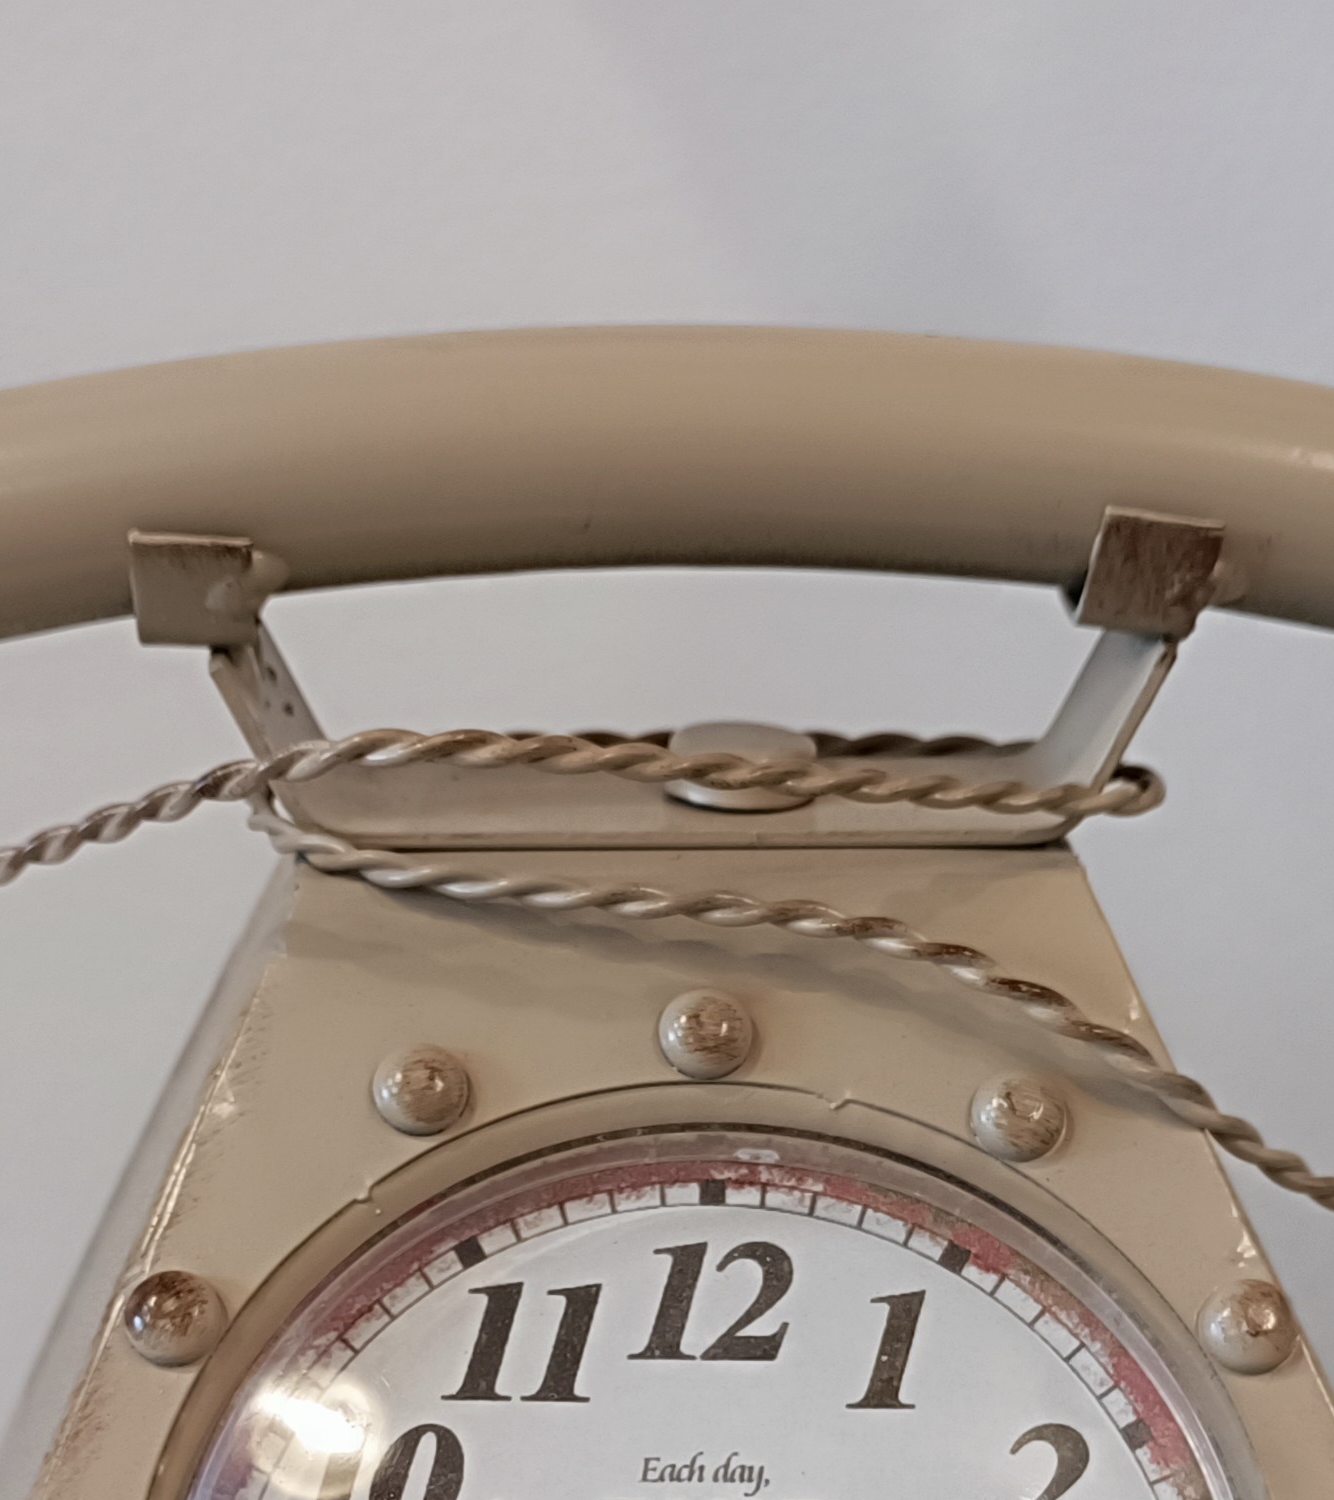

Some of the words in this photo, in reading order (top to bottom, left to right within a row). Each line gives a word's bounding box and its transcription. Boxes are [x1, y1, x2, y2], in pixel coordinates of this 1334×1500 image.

[440, 1281, 603, 1403] 11
[626, 1241, 795, 1362] 12
[845, 1289, 927, 1410] 1
[638, 1451, 705, 1484] Each
[711, 1451, 770, 1498] day,
